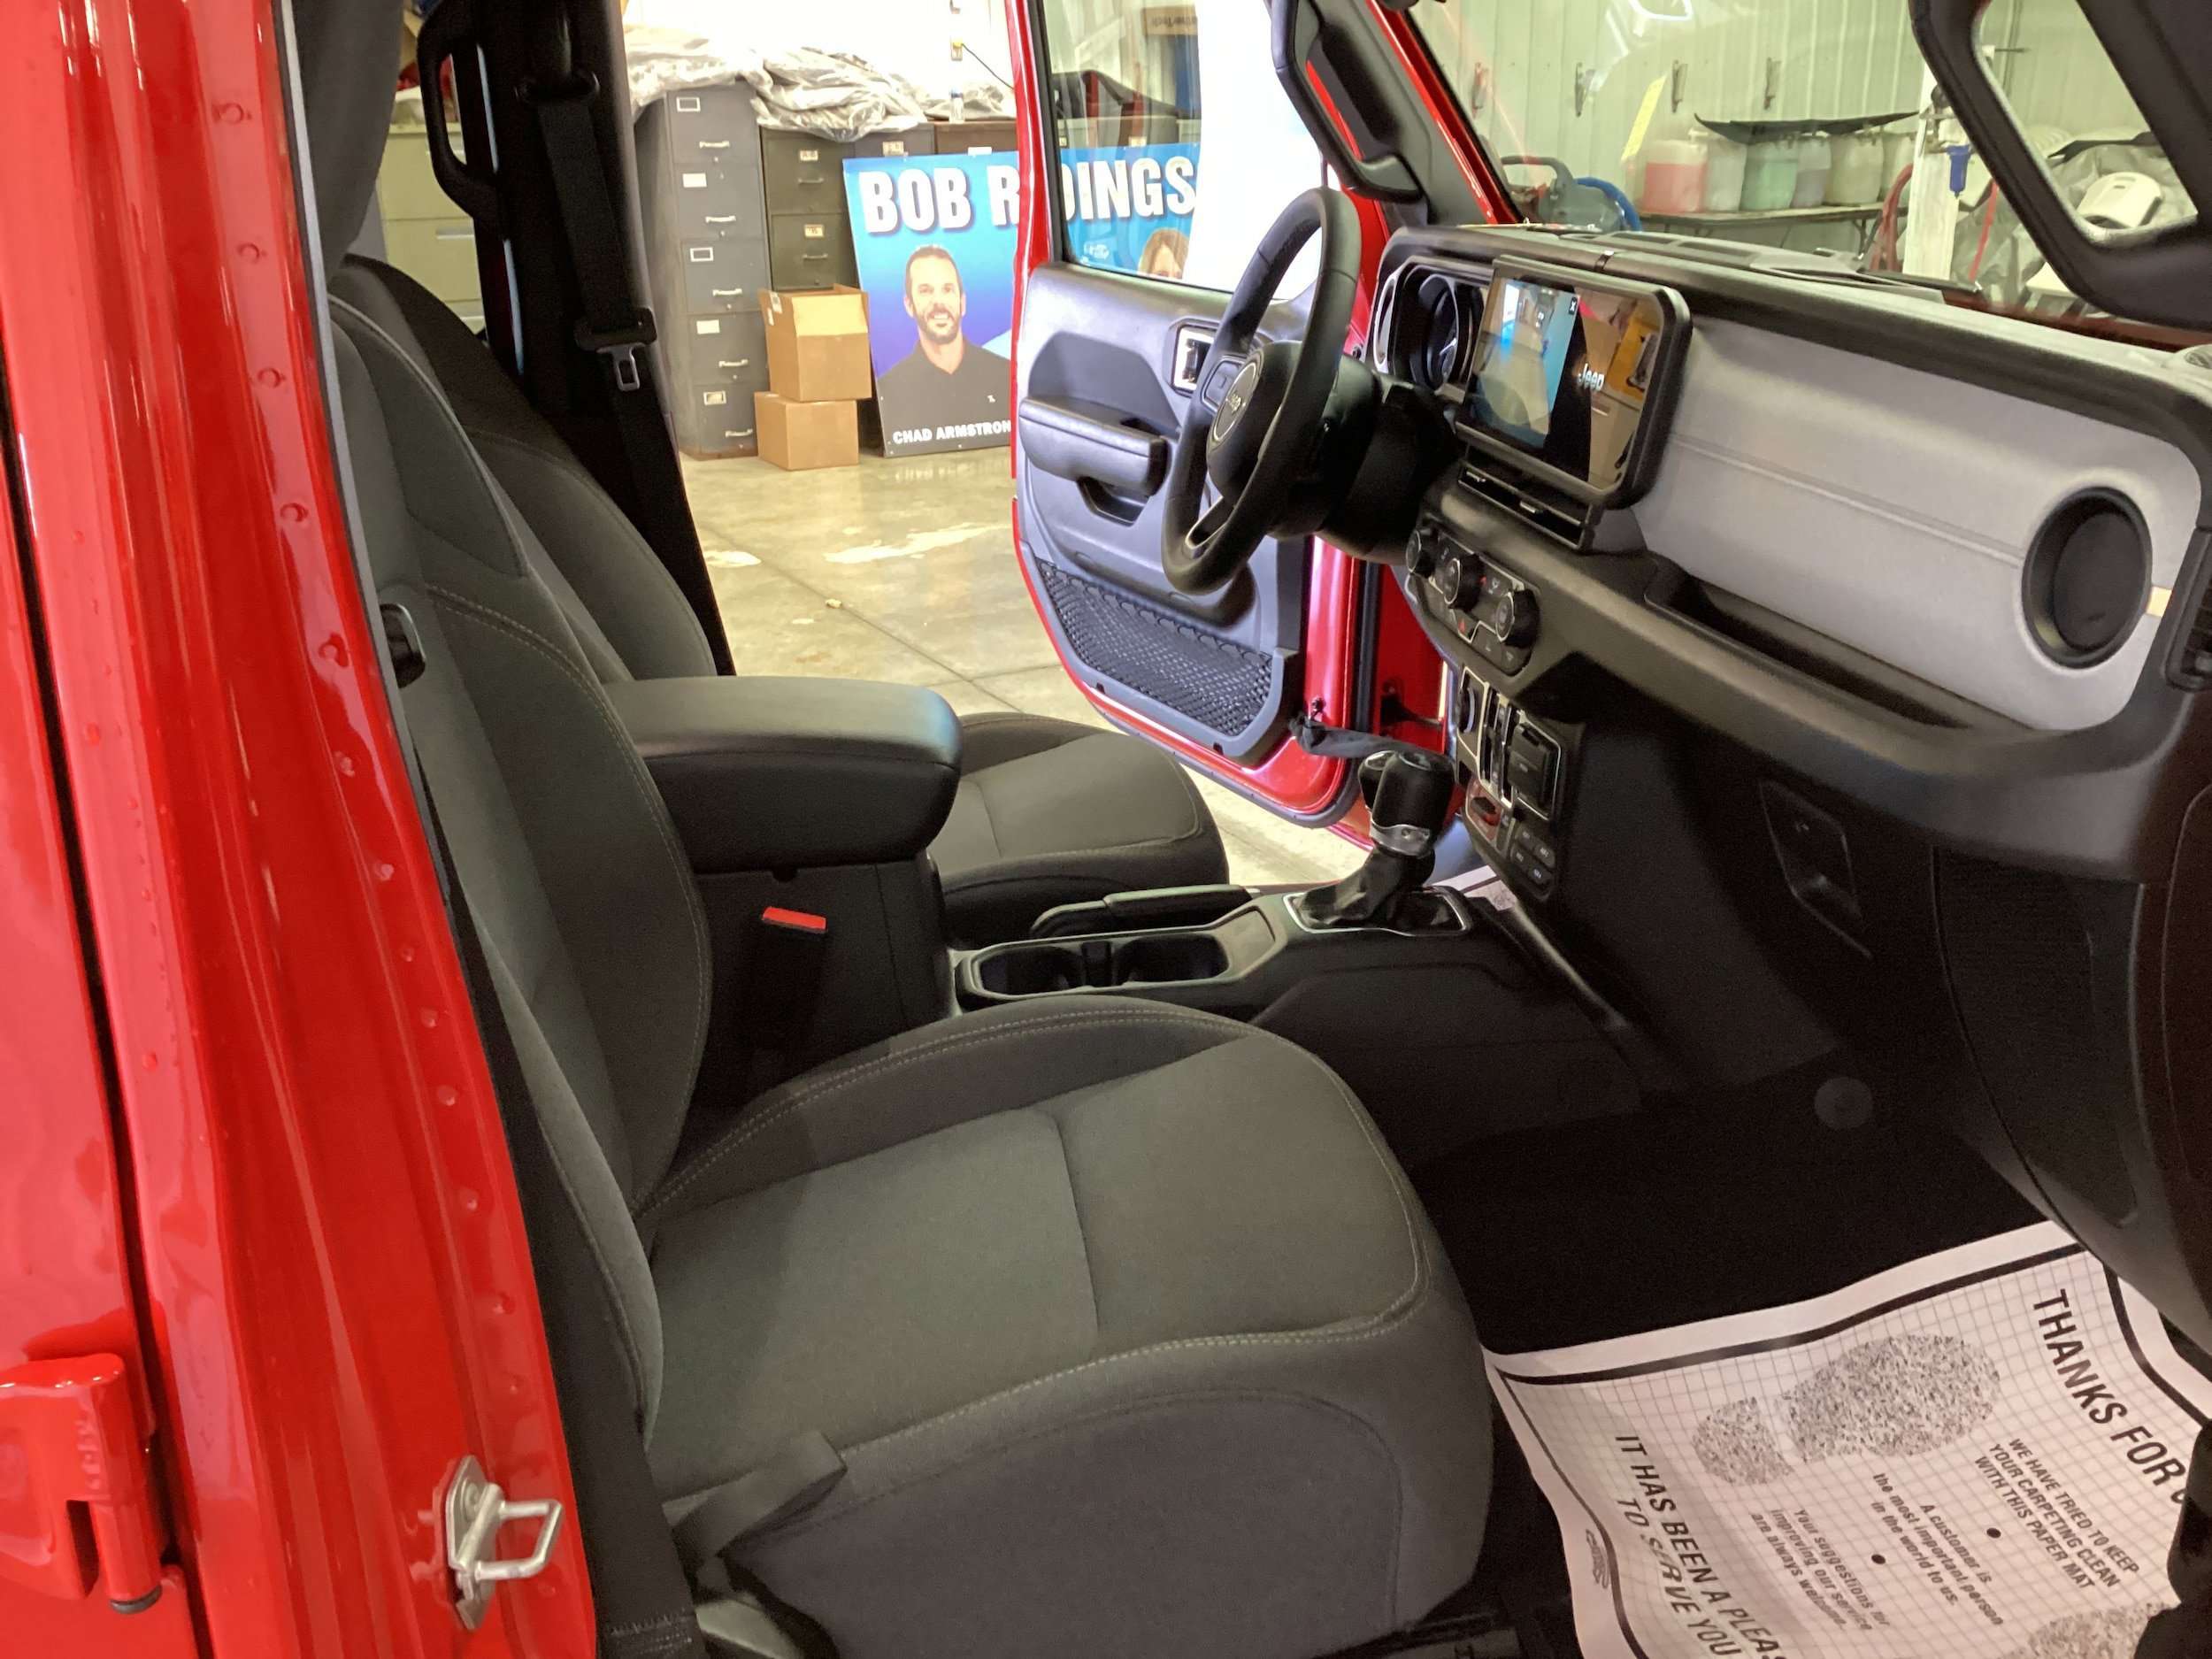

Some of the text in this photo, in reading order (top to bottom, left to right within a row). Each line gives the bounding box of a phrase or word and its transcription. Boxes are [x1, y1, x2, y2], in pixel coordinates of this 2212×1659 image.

[858, 156, 1196, 233] BOB RINGS
[893, 428, 933, 444] CHAD
[1577, 363, 1605, 391] Jeep
[2033, 1288, 2186, 1486] THANKS FOR
[1615, 1436, 1786, 1659] IT HAS BEEN A PLEA
[1751, 1513, 1771, 1532] are
[1767, 1535, 1803, 1577] always
[1793, 1509, 1818, 1534] Your
[1814, 1536, 1874, 1609] suggestions
[1870, 1502, 1886, 1513] in
[1882, 1515, 1902, 1533] the
[1900, 1535, 1934, 1569] world
[1927, 1571, 1944, 1583] to
[1873, 1472, 2004, 1625] the most important person
[1930, 1516, 1980, 1569] customer
[1976, 1571, 1992, 1584] is
[1975, 1456, 2095, 1588] WITH THIS PAPER MAT
[1989, 1443, 2121, 1587] YOUR CARPETING CLEAN
[2008, 1439, 2139, 1573] WE HAVE TRIED TO KEEP
[1617, 1498, 1742, 1656] TO SERVE YOU
[1770, 1509, 1872, 1630] improving our service
